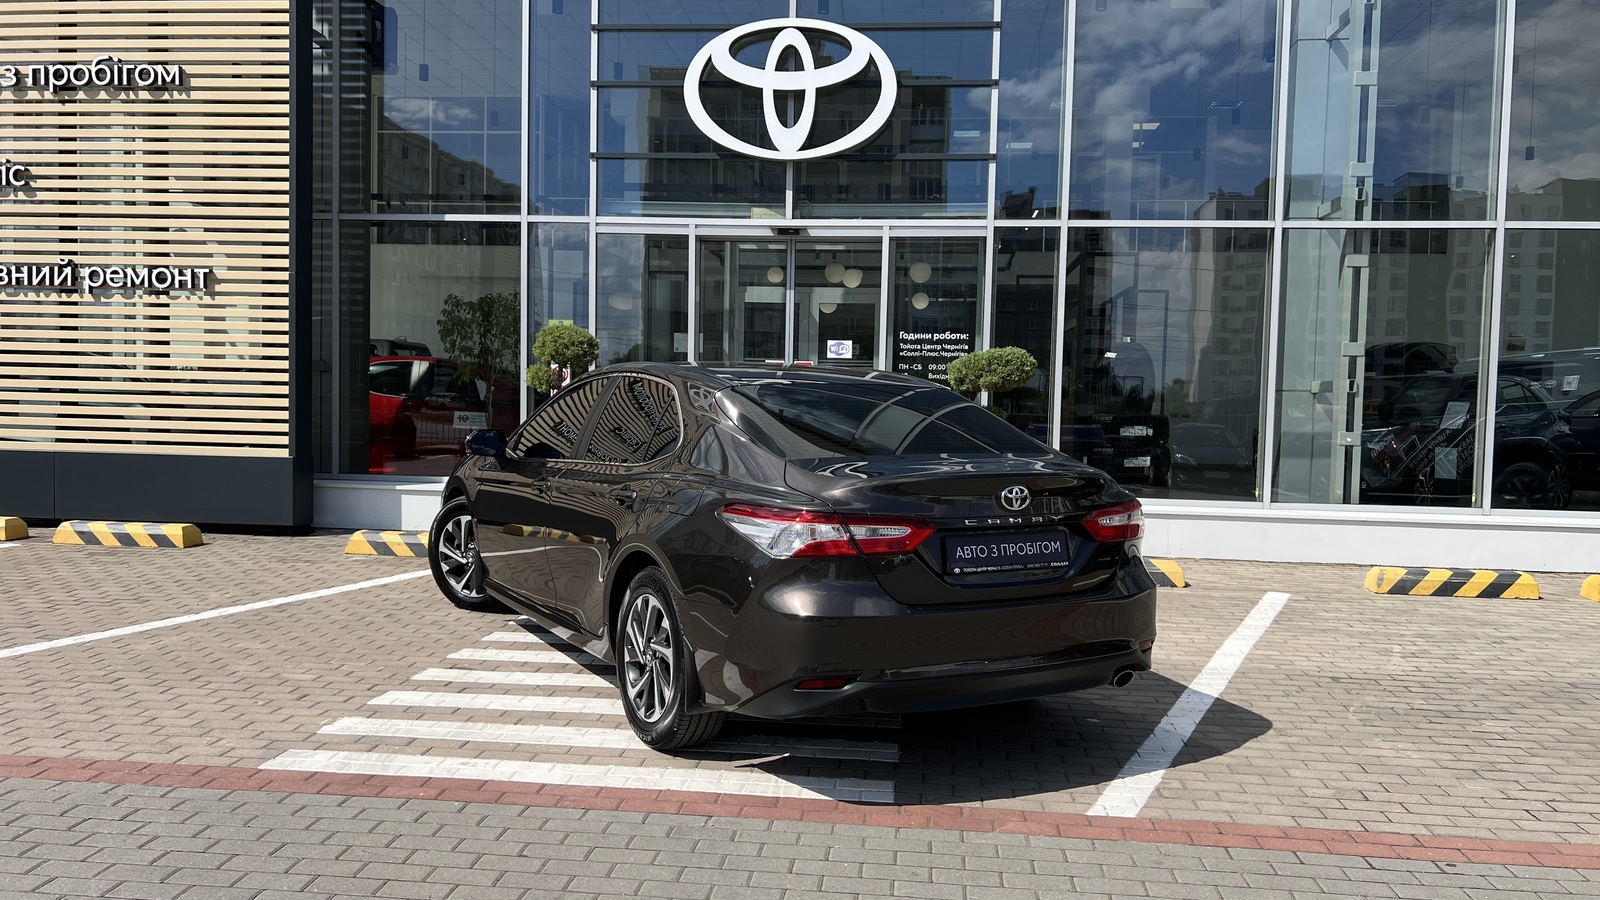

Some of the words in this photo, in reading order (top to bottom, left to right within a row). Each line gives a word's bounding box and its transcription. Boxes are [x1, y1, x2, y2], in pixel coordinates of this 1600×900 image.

[28, 55, 180, 93] пробігом
[84, 265, 210, 293] ремонт
[899, 331, 932, 341] Години
[933, 331, 969, 342] роботи:
[921, 343, 942, 351] Центр
[942, 343, 969, 351] Чернігів
[964, 515, 1062, 525] CAMRY
[956, 545, 988, 559] АВТО
[990, 544, 998, 557] З
[1000, 540, 1061, 556] ПРОБІГОМ
